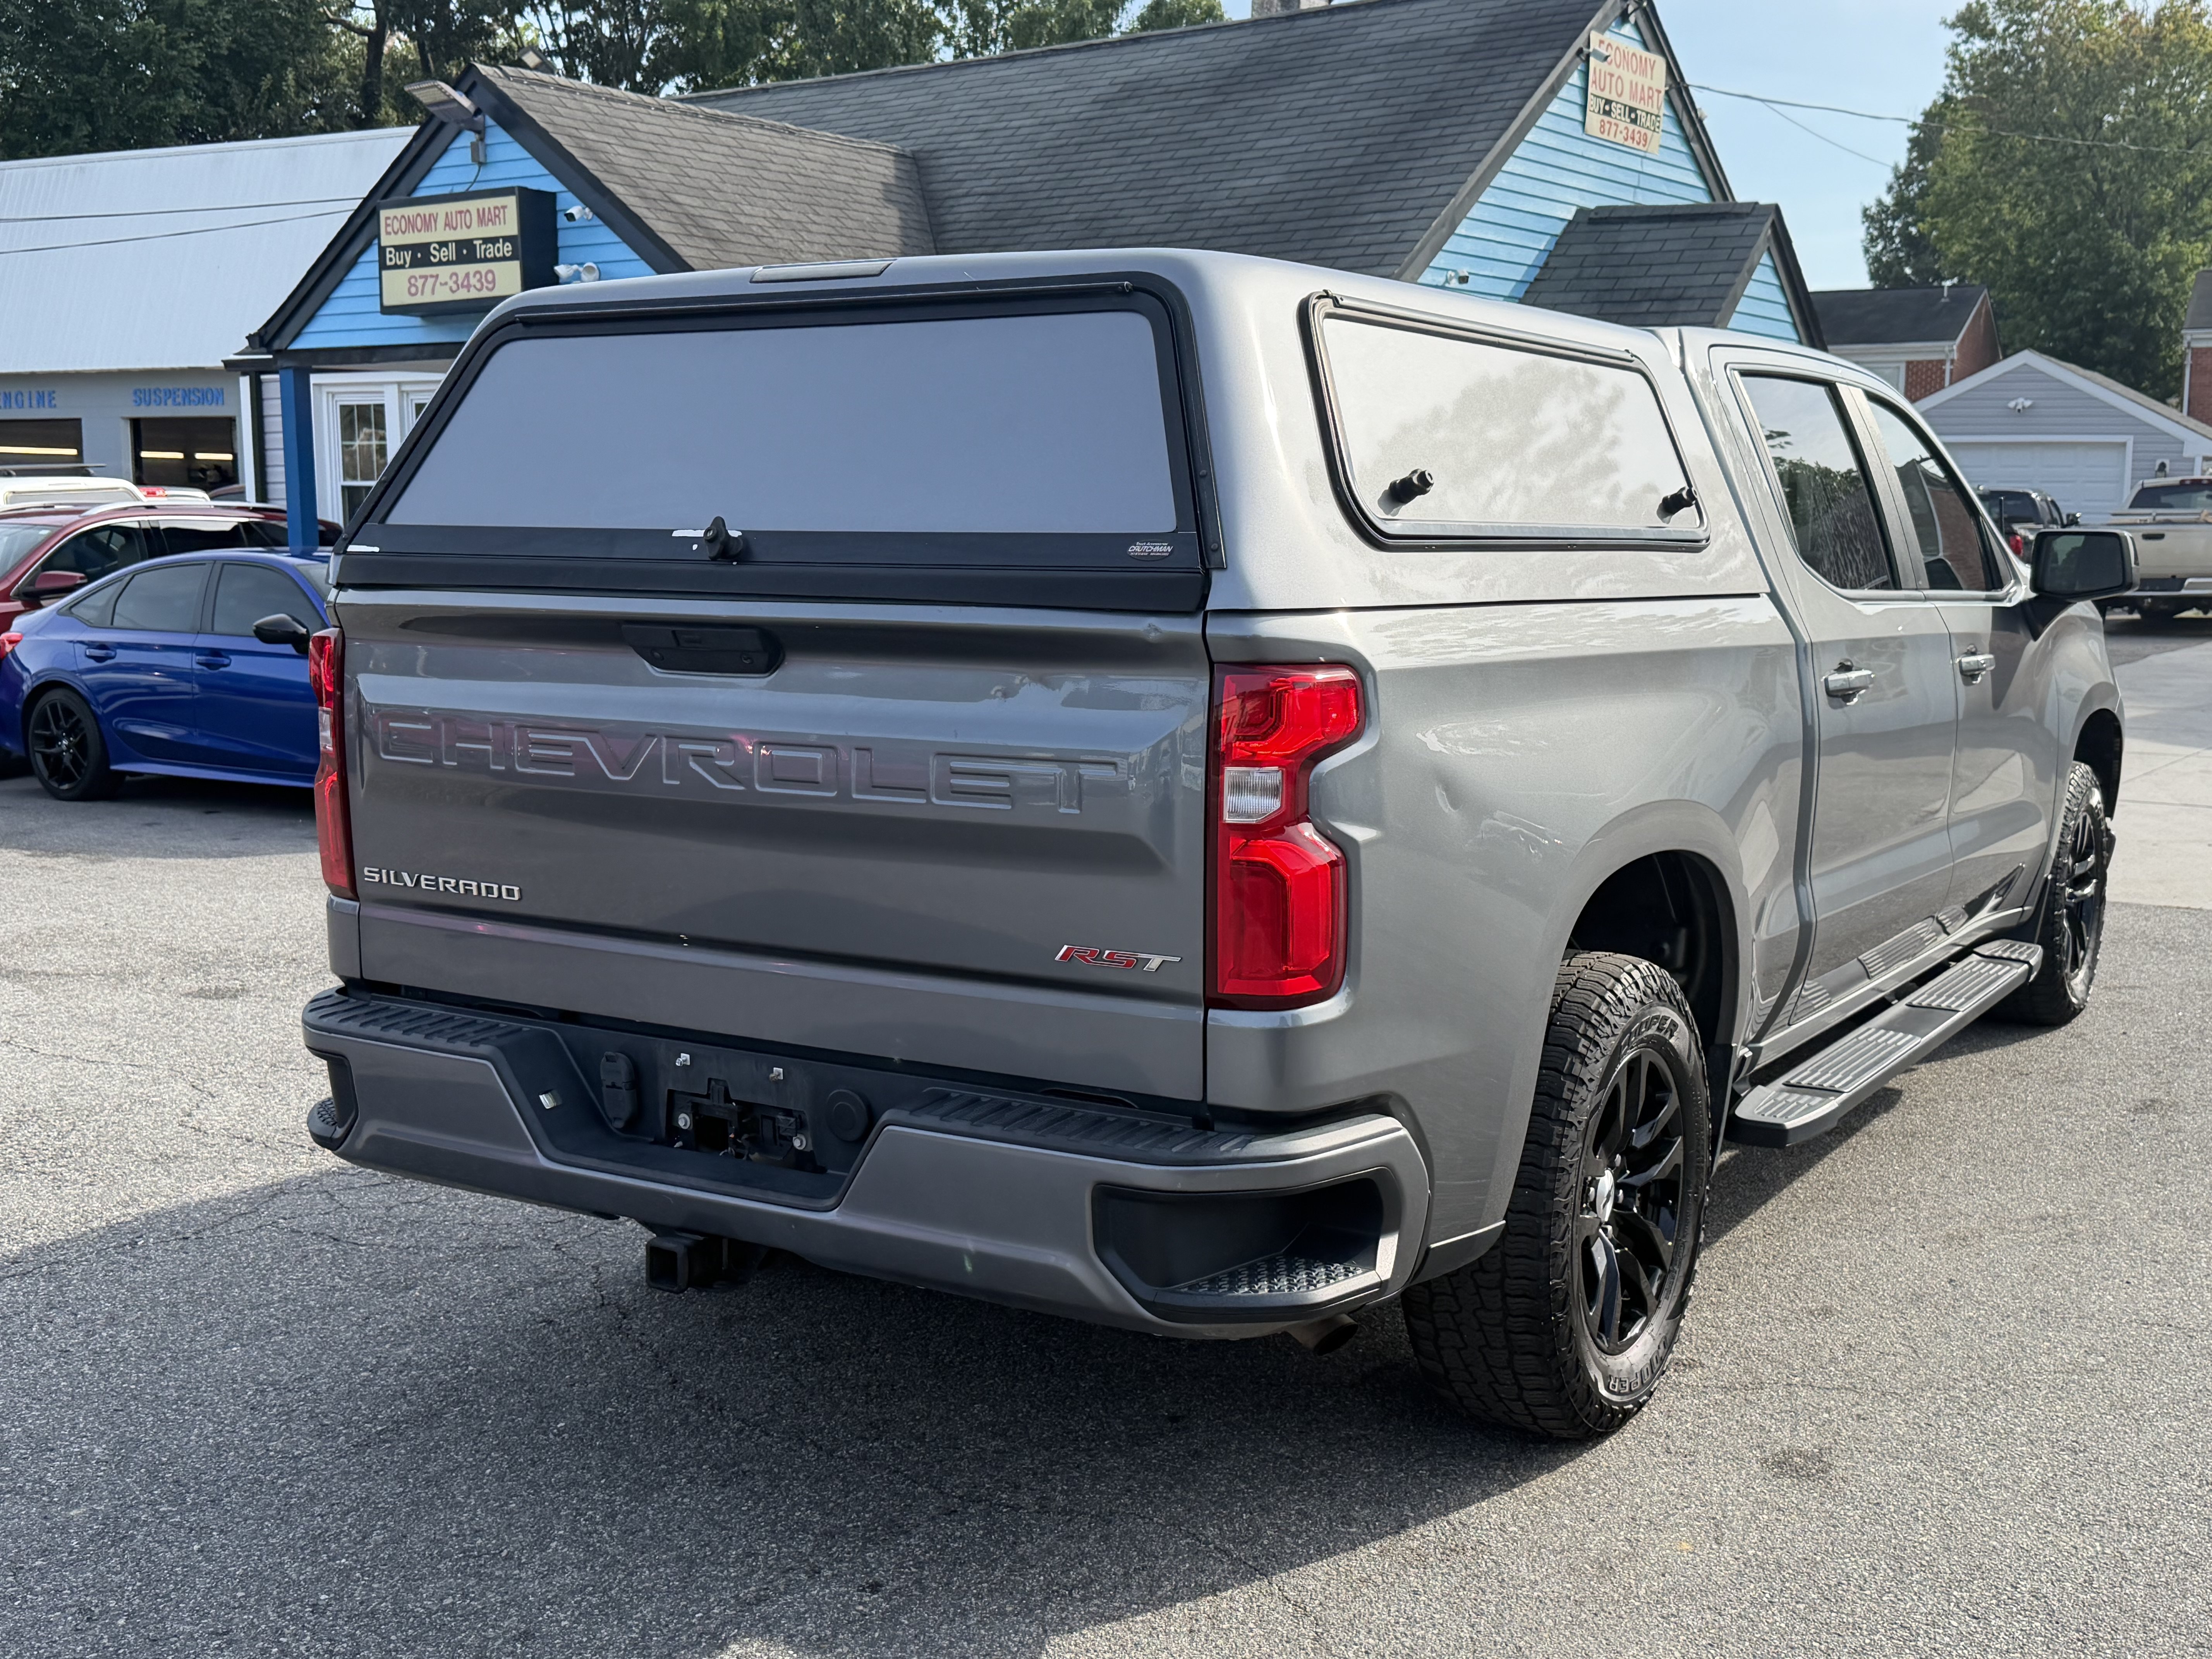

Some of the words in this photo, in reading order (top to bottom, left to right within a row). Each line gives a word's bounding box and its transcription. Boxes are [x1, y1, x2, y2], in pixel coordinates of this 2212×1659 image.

[1591, 67, 1624, 98] AUTO
[1629, 80, 1662, 111] MART
[1590, 95, 1605, 114] BUY
[1611, 102, 1630, 123] SELL
[1637, 110, 1661, 132] TRADE
[1599, 119, 1648, 148] 877-3439
[385, 212, 438, 235] ECONOMY
[443, 209, 472, 231] AUTO
[477, 205, 508, 227] MART
[386, 247, 411, 268] Buy
[430, 241, 456, 263] Sell
[473, 238, 512, 259] Trade
[407, 269, 496, 297] 877-3439
[0, 390, 57, 409] NGINE
[133, 387, 224, 407] SUSPENSION
[378, 713, 1118, 814] CHEVROLET
[364, 867, 521, 901] SILVERADO
[1054, 945, 1182, 972] RST
[1621, 1014, 1679, 1055] COOPER
[1609, 1335, 1668, 1393] COOPER
